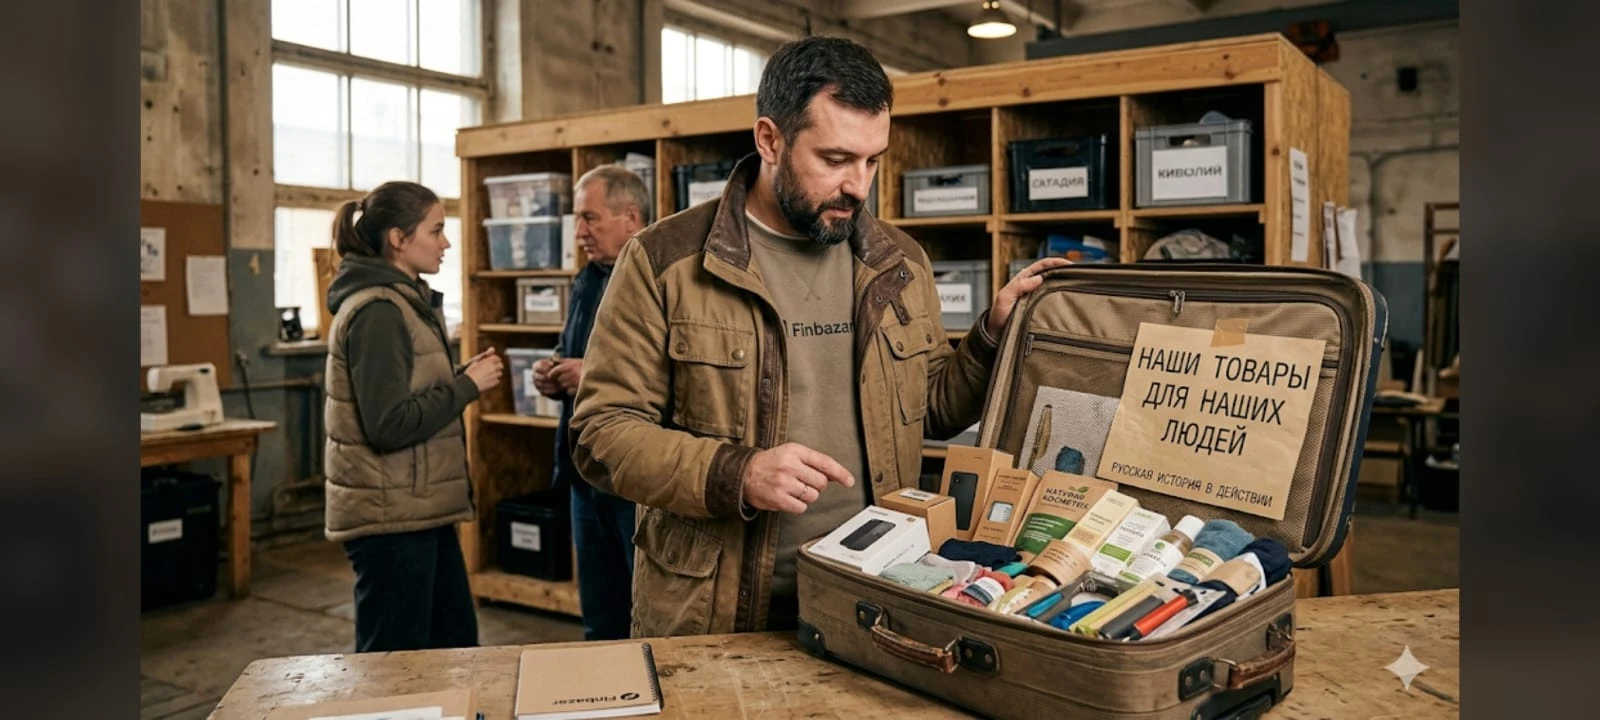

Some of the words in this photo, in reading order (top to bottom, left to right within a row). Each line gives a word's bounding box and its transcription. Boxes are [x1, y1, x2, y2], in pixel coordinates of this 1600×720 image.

[1137, 347, 1201, 376] НАШИ
[1214, 355, 1311, 390] ТОВАРЫ
[1142, 382, 1189, 410] ДЛЯ
[1200, 389, 1285, 425] НАШИХ
[1161, 418, 1247, 456] ЛЮДЕЙ
[1111, 462, 1153, 480] РУССКАЯ
[1157, 473, 1202, 491] ИСТОРИЯ
[1205, 483, 1213, 494] В
[1216, 485, 1273, 508] ДЕЙСТВИИ
